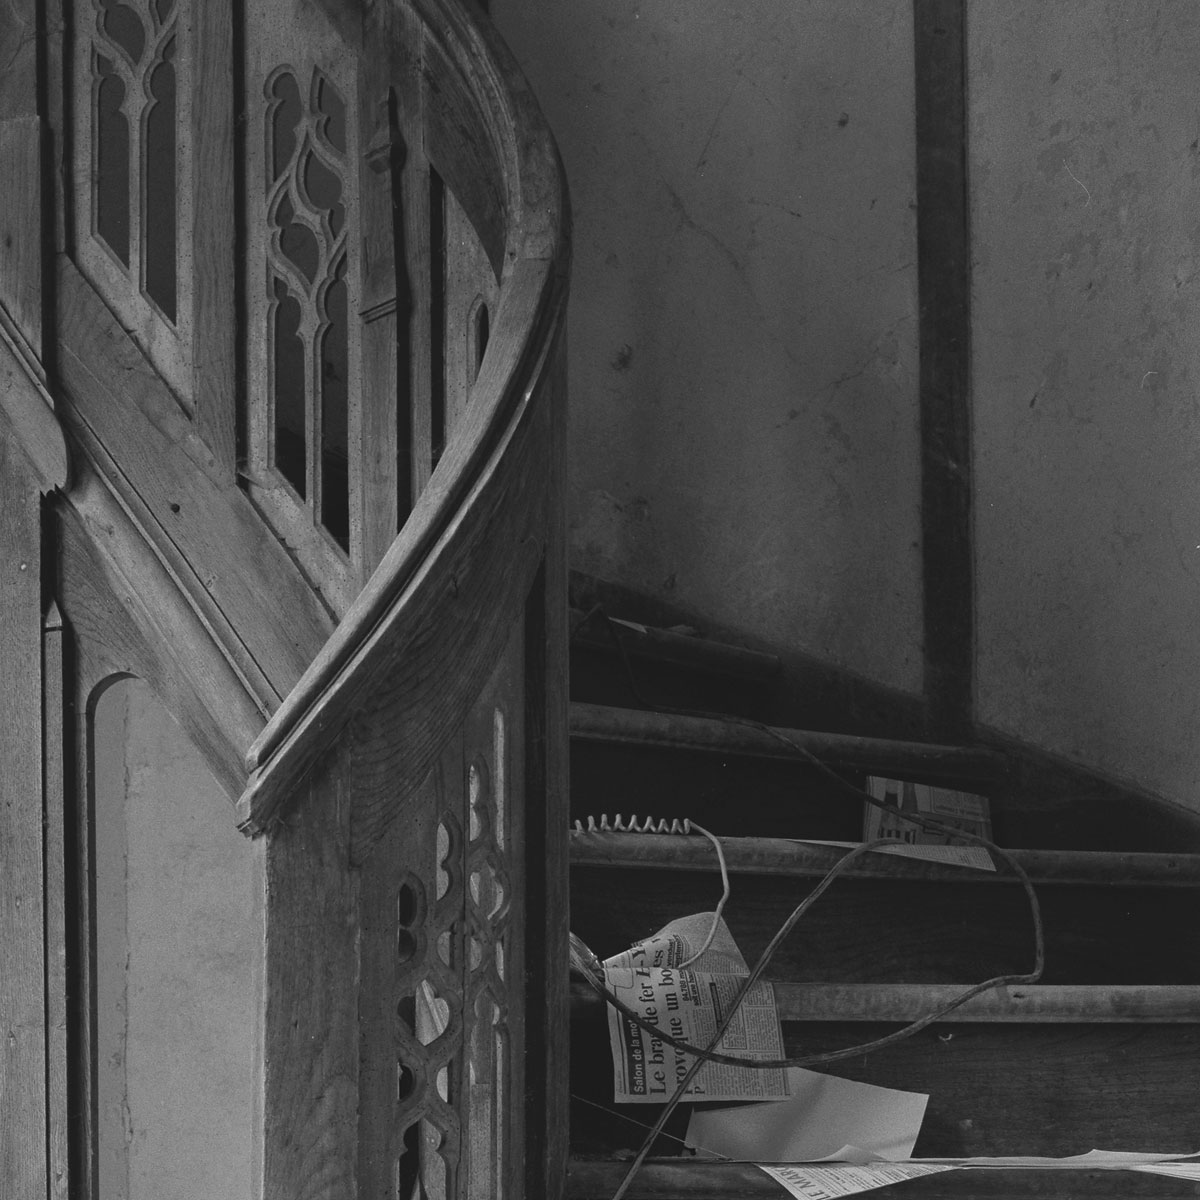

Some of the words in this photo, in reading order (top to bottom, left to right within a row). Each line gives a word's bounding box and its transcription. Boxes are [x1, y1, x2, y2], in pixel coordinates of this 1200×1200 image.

[638, 983, 656, 1003] fer
[666, 992, 680, 1012] un
[642, 1006, 659, 1026] de
[631, 1048, 643, 1062] de
[632, 1065, 645, 1093] Salon
[649, 1071, 667, 1095] Le
